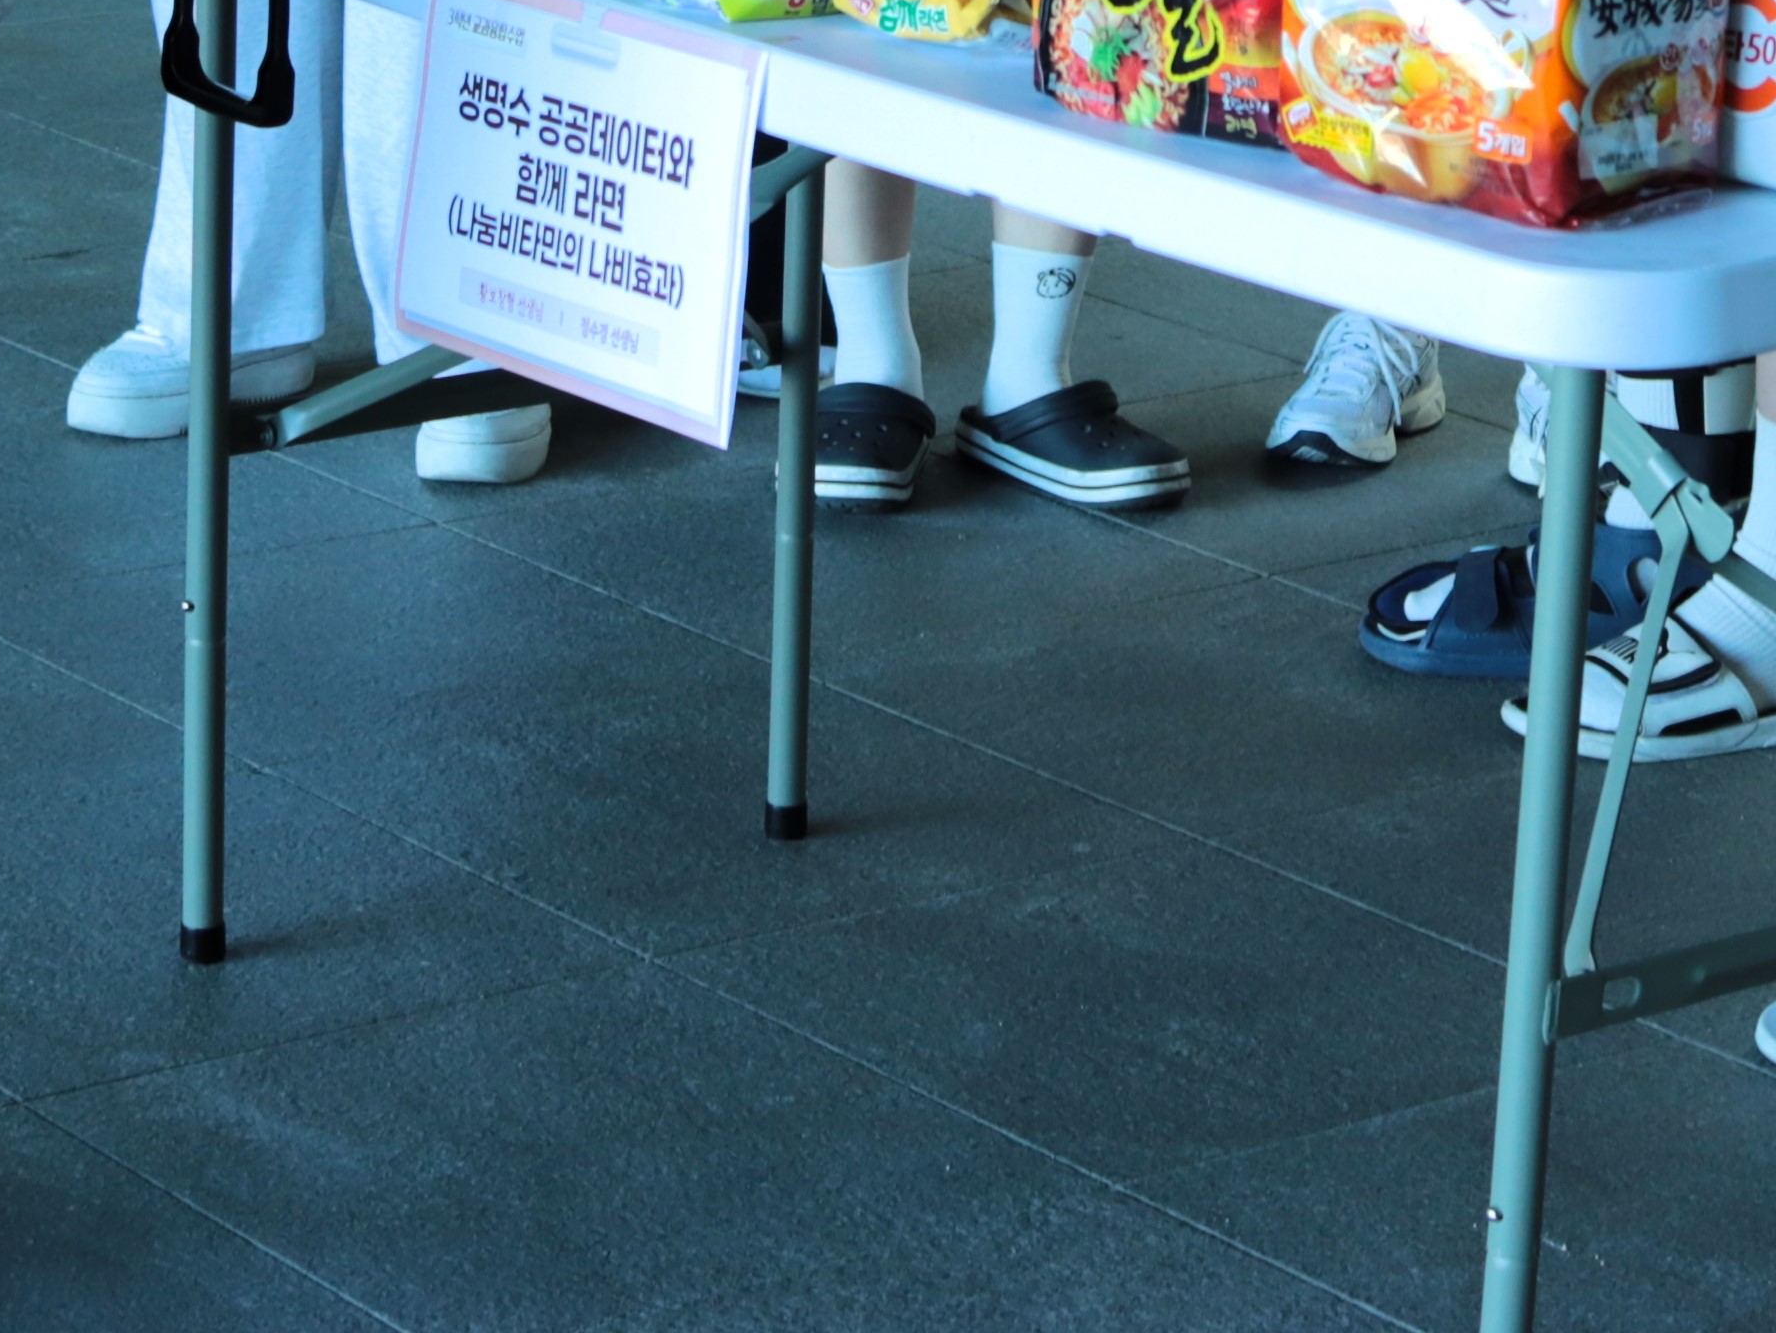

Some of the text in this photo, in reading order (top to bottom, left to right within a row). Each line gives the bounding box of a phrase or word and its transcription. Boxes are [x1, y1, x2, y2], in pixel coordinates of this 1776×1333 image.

[459, 71, 696, 190] 생명수 공공데이터와
[1476, 121, 1530, 157] 5개입
[516, 153, 627, 232] 함께 라면
[447, 193, 686, 311] (나눔비타민의 나비효과)
